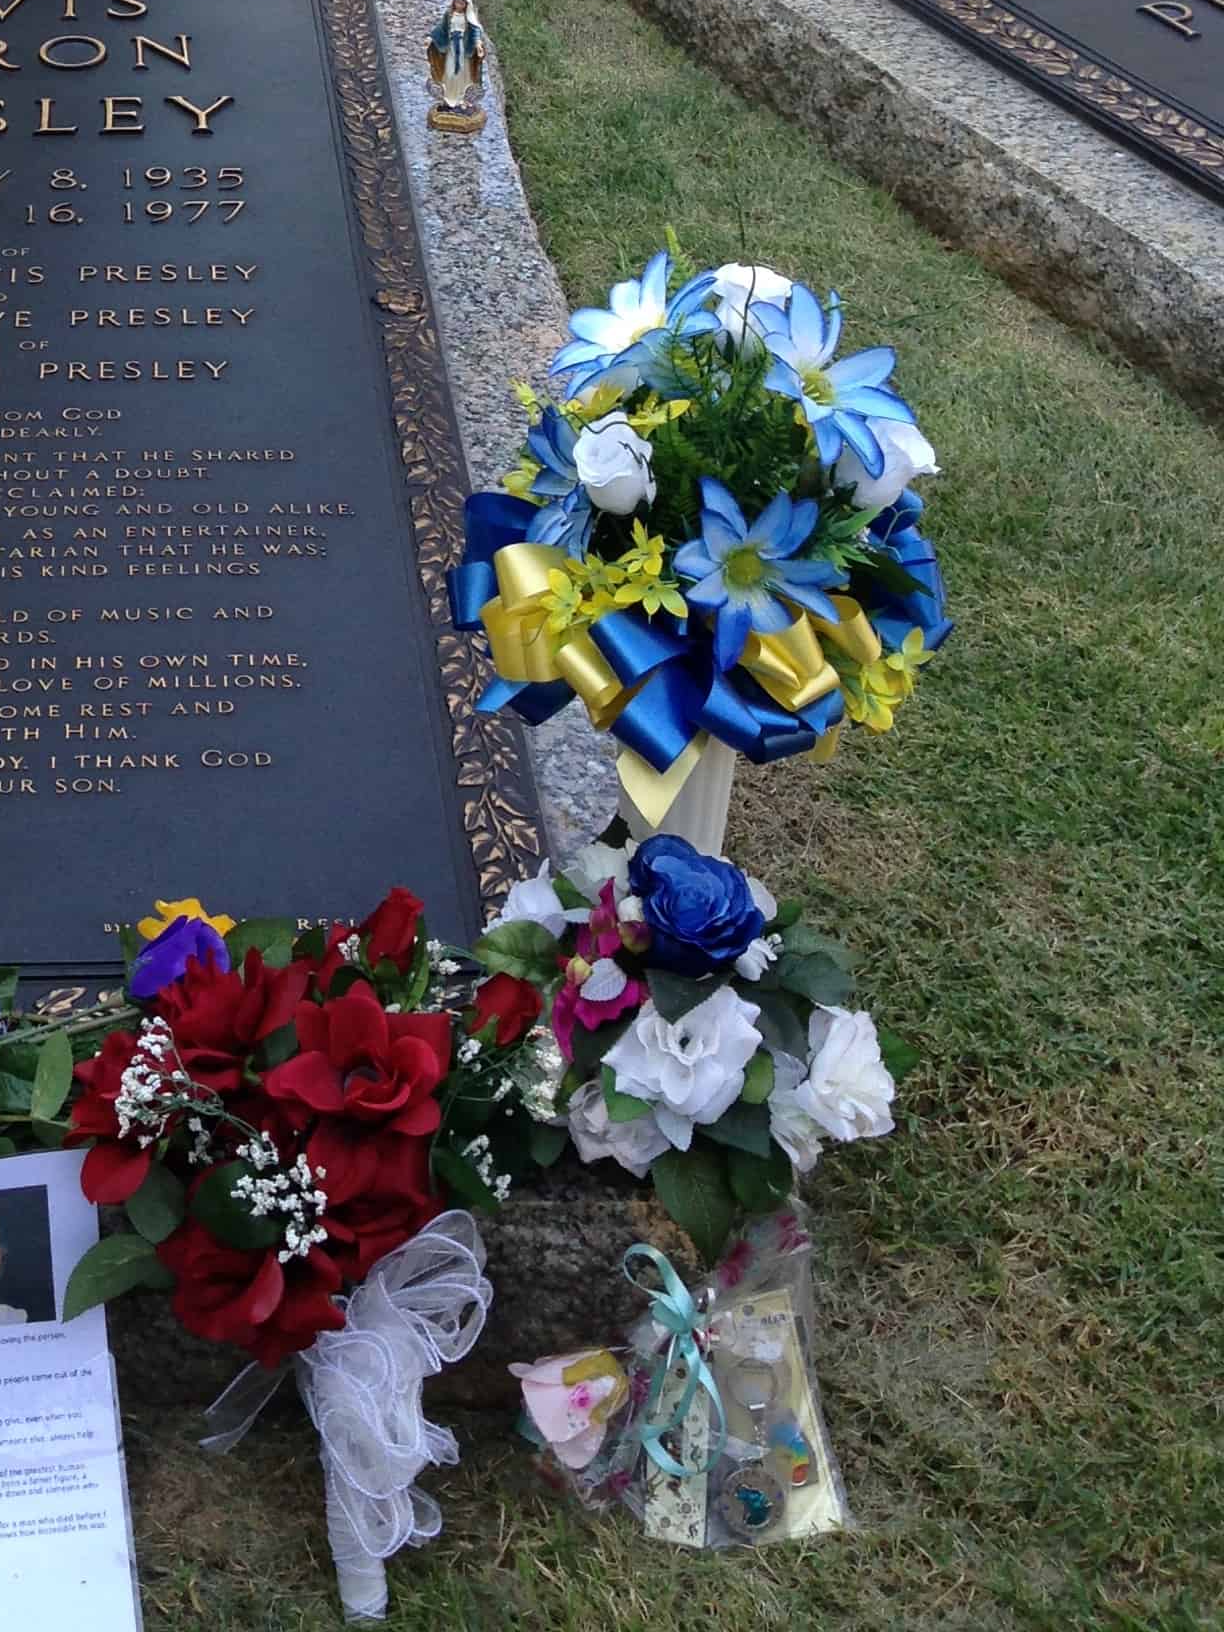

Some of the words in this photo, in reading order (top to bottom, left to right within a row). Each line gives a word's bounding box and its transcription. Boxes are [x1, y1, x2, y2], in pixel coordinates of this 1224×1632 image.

[125, 166, 244, 188] 1935
[125, 200, 245, 222] 1977
[1, 247, 31, 257] OF
[79, 263, 257, 282] PRESLEY
[71, 307, 255, 326] PRESLEY
[18, 340, 49, 350] OF
[39, 360, 228, 380] PRESLEY
[52, 450, 127, 462] THAT
[143, 449, 175, 461] HE
[191, 449, 295, 461] SHARED
[3, 503, 101, 518] YOUNG
[115, 503, 173, 515] AND
[192, 502, 249, 514] OLD
[47, 608, 83, 622] OF
[100, 607, 193, 621] MUSIC
[212, 605, 273, 619] AND
[50, 755, 57, 769] I
[73, 753, 180, 769] THANK
